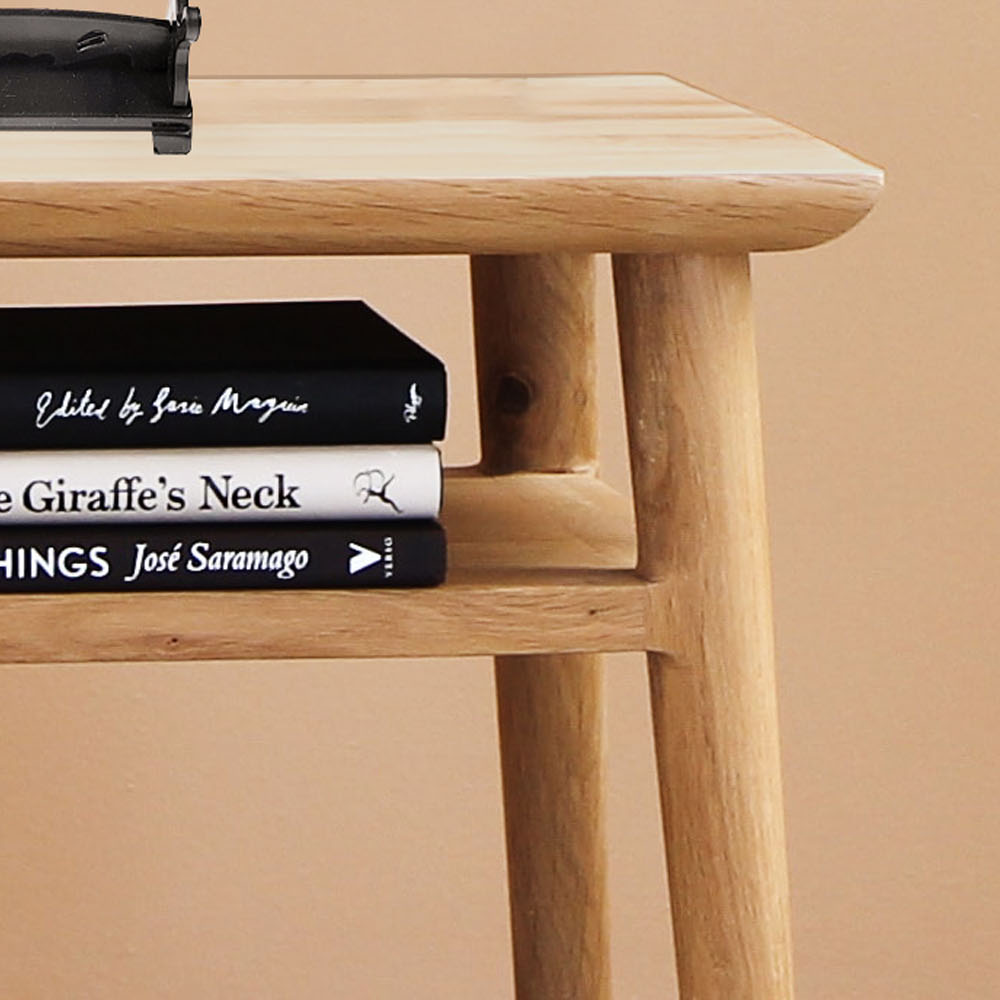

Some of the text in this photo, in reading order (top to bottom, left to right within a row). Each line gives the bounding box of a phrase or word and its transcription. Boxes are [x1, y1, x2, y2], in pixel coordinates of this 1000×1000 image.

[35, 388, 111, 429] Edited
[118, 386, 144, 426] by
[22, 476, 187, 514] Giraffe's
[199, 473, 302, 511] Neck
[124, 542, 309, 582] José Saramago
